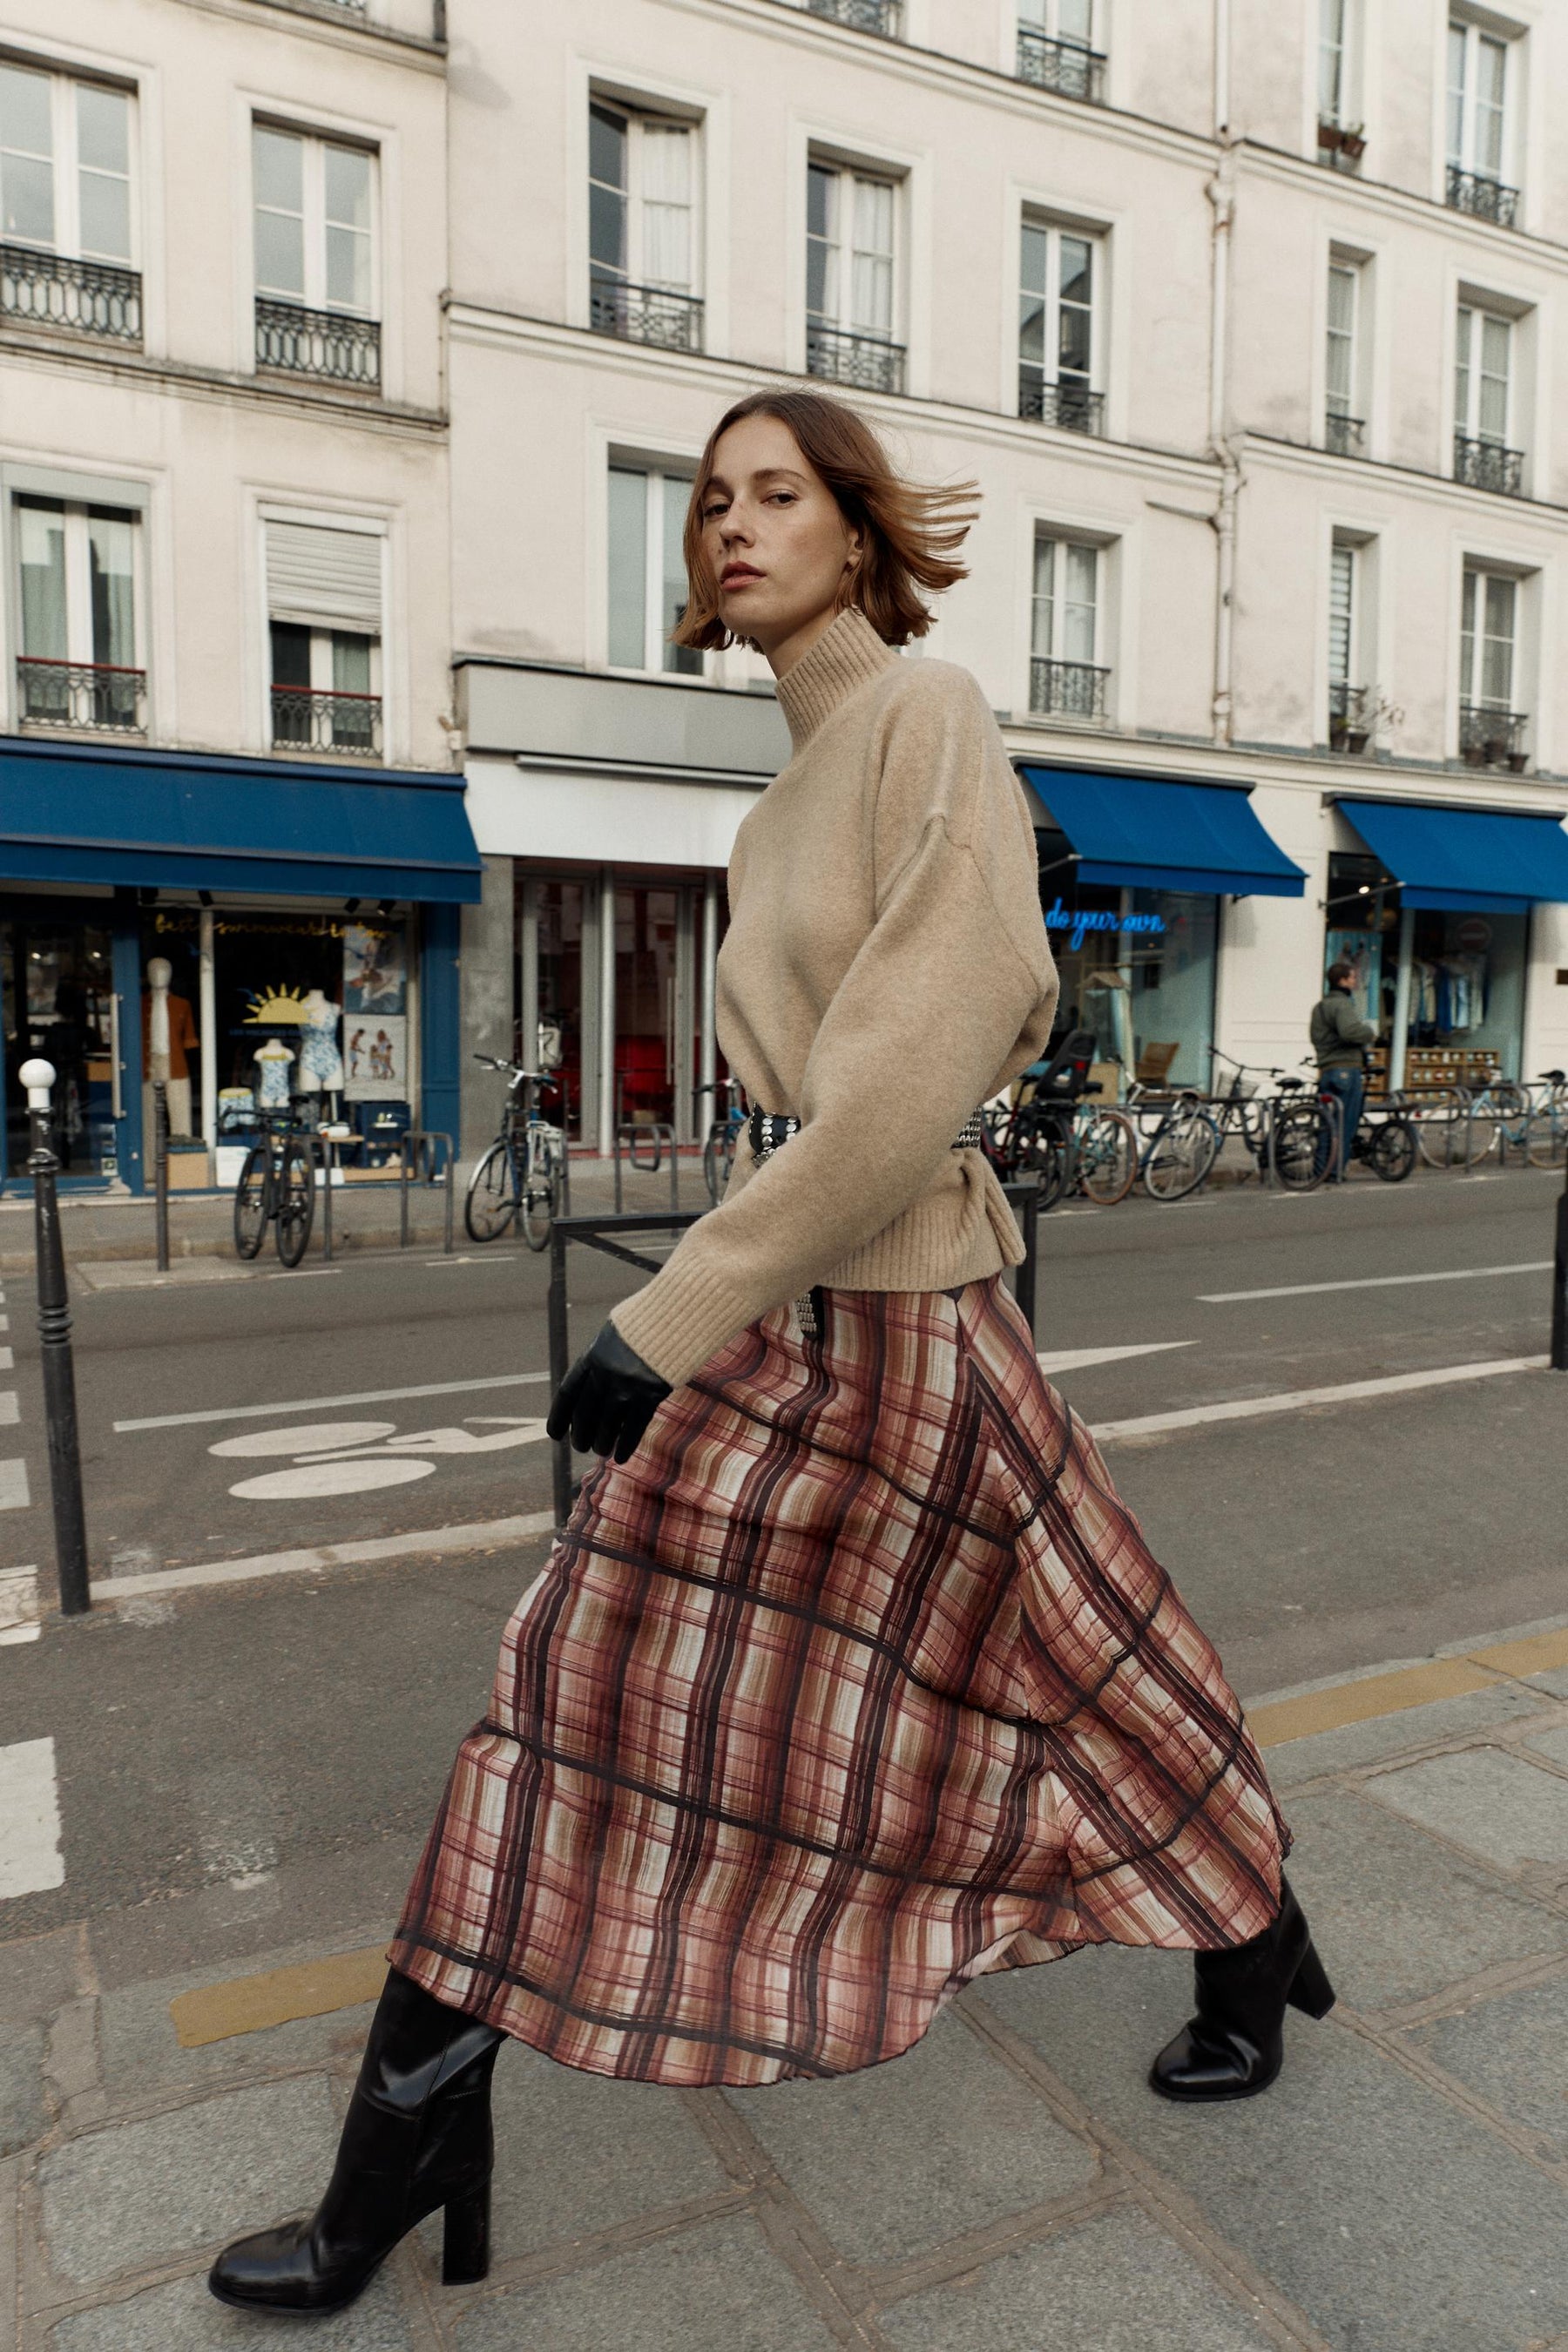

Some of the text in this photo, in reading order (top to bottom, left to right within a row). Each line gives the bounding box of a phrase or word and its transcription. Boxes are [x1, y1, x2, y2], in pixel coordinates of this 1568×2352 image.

[1045, 896, 1167, 951] do your own
